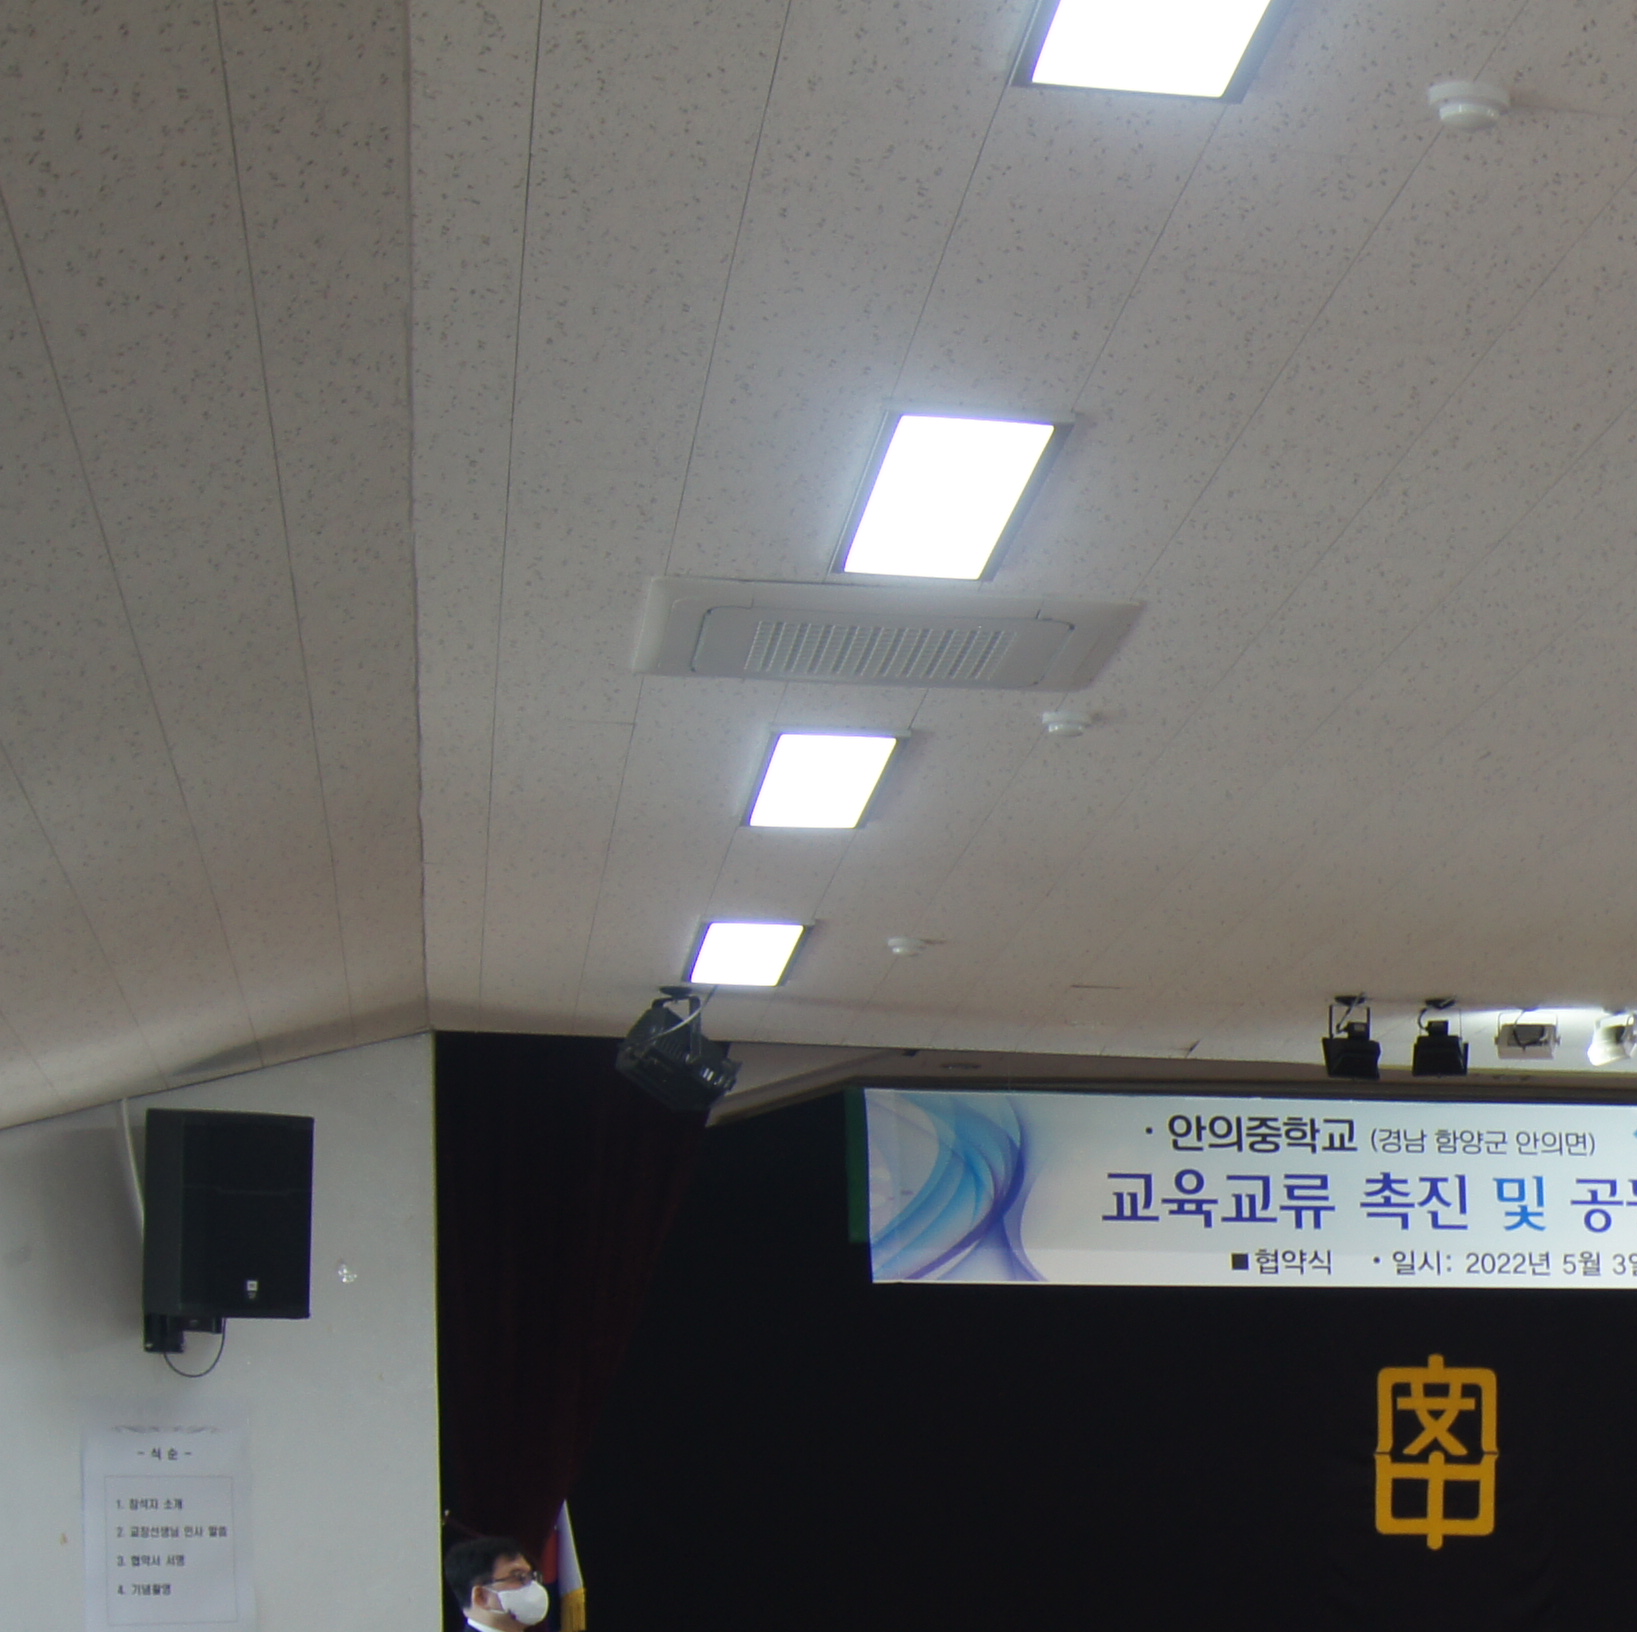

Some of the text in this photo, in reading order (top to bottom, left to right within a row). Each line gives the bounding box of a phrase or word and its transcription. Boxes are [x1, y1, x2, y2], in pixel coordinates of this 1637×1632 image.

[1167, 1115, 1597, 1158] 안의중학교 (경남 함양군 안의면)
[1101, 1168, 1336, 1230] 교육교류
[1359, 1172, 1469, 1232] 촉진
[1492, 1174, 1547, 1232] 및
[1255, 1248, 1333, 1276] 협약식
[1391, 1250, 1452, 1276] 일시:
[1465, 1250, 1551, 1277] 2022년
[1562, 1250, 1602, 1278] 5월
